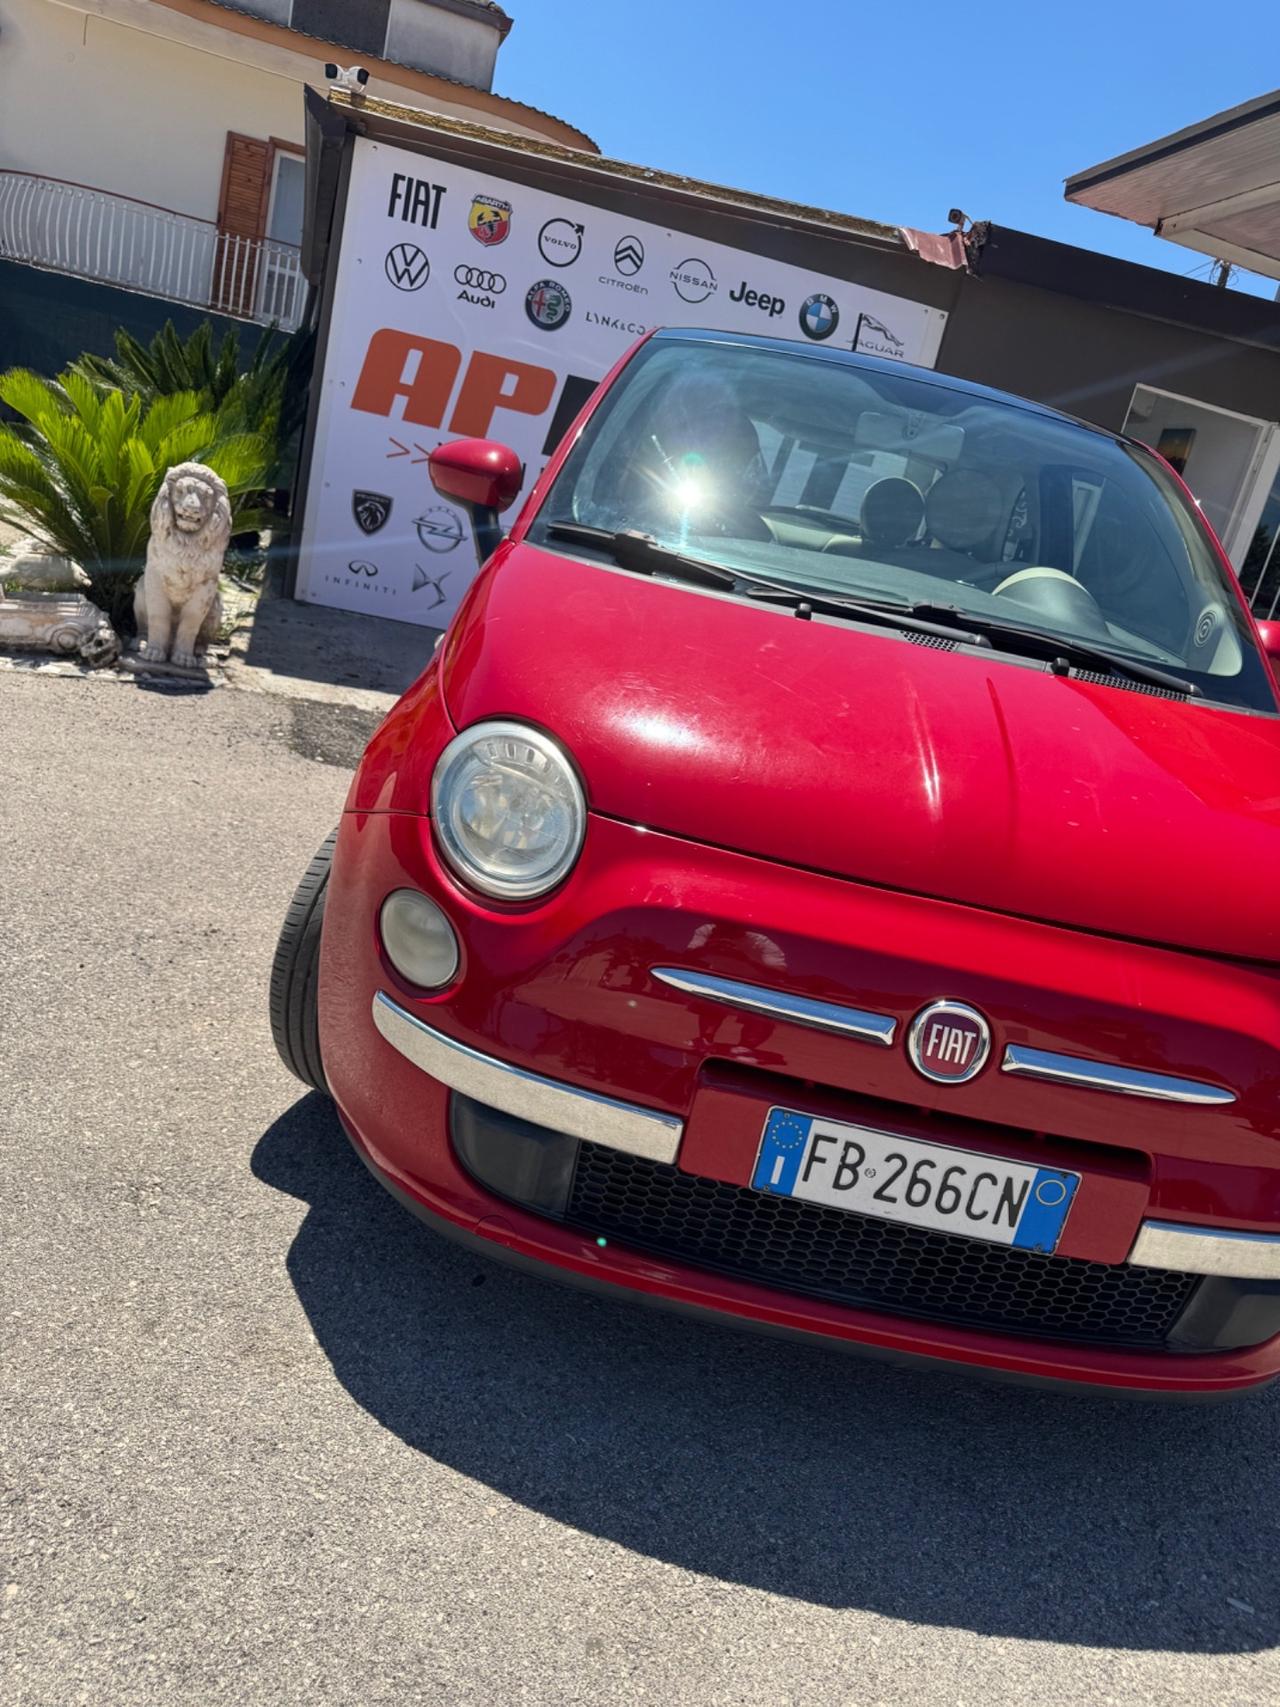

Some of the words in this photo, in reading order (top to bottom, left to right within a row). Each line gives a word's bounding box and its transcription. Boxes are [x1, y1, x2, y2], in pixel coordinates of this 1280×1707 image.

[387, 173, 447, 230] FIAT
[543, 235, 577, 250] VOLVO
[669, 271, 718, 291] NISSAN
[456, 289, 496, 309] Audi
[528, 281, 547, 301] ALFA
[549, 281, 571, 312] ROMEO
[729, 281, 786, 317] Jeep
[806, 294, 840, 314] BMW
[324, 575, 397, 596] INFINITI
[926, 1022, 977, 1065] FIAT
